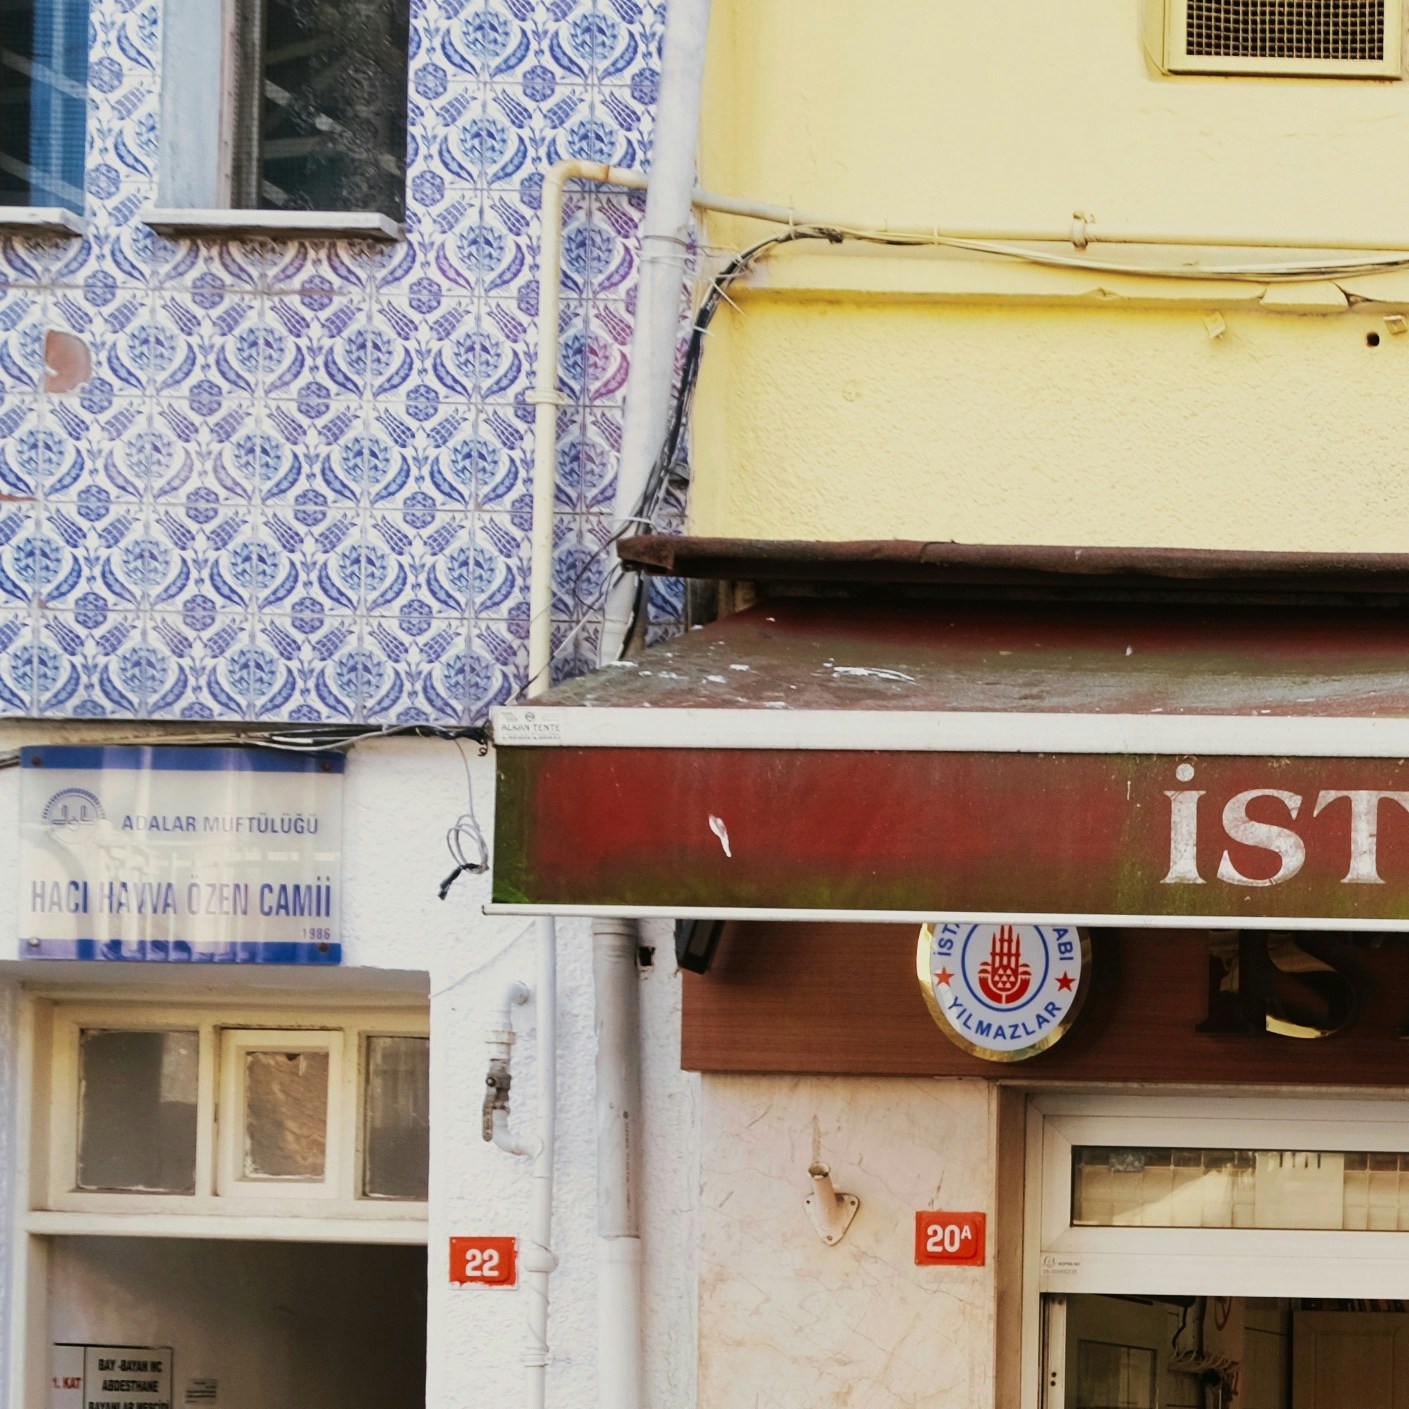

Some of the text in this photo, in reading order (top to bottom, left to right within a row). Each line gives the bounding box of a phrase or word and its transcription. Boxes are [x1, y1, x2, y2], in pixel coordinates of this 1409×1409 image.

[534, 723, 560, 732] TENTE
[121, 814, 197, 833] ADALAR
[31, 879, 89, 914] HACI
[186, 874, 249, 916] ÖZEN
[258, 875, 332, 918] CAMİİ
[302, 927, 331, 940] 1986
[948, 996, 1062, 1040] YILMAZLAR
[464, 1248, 500, 1278] 22
[98, 1358, 116, 1371] BAY
[63, 1376, 82, 1389] KAT
[101, 1379, 159, 1392] ABDESTHANE
